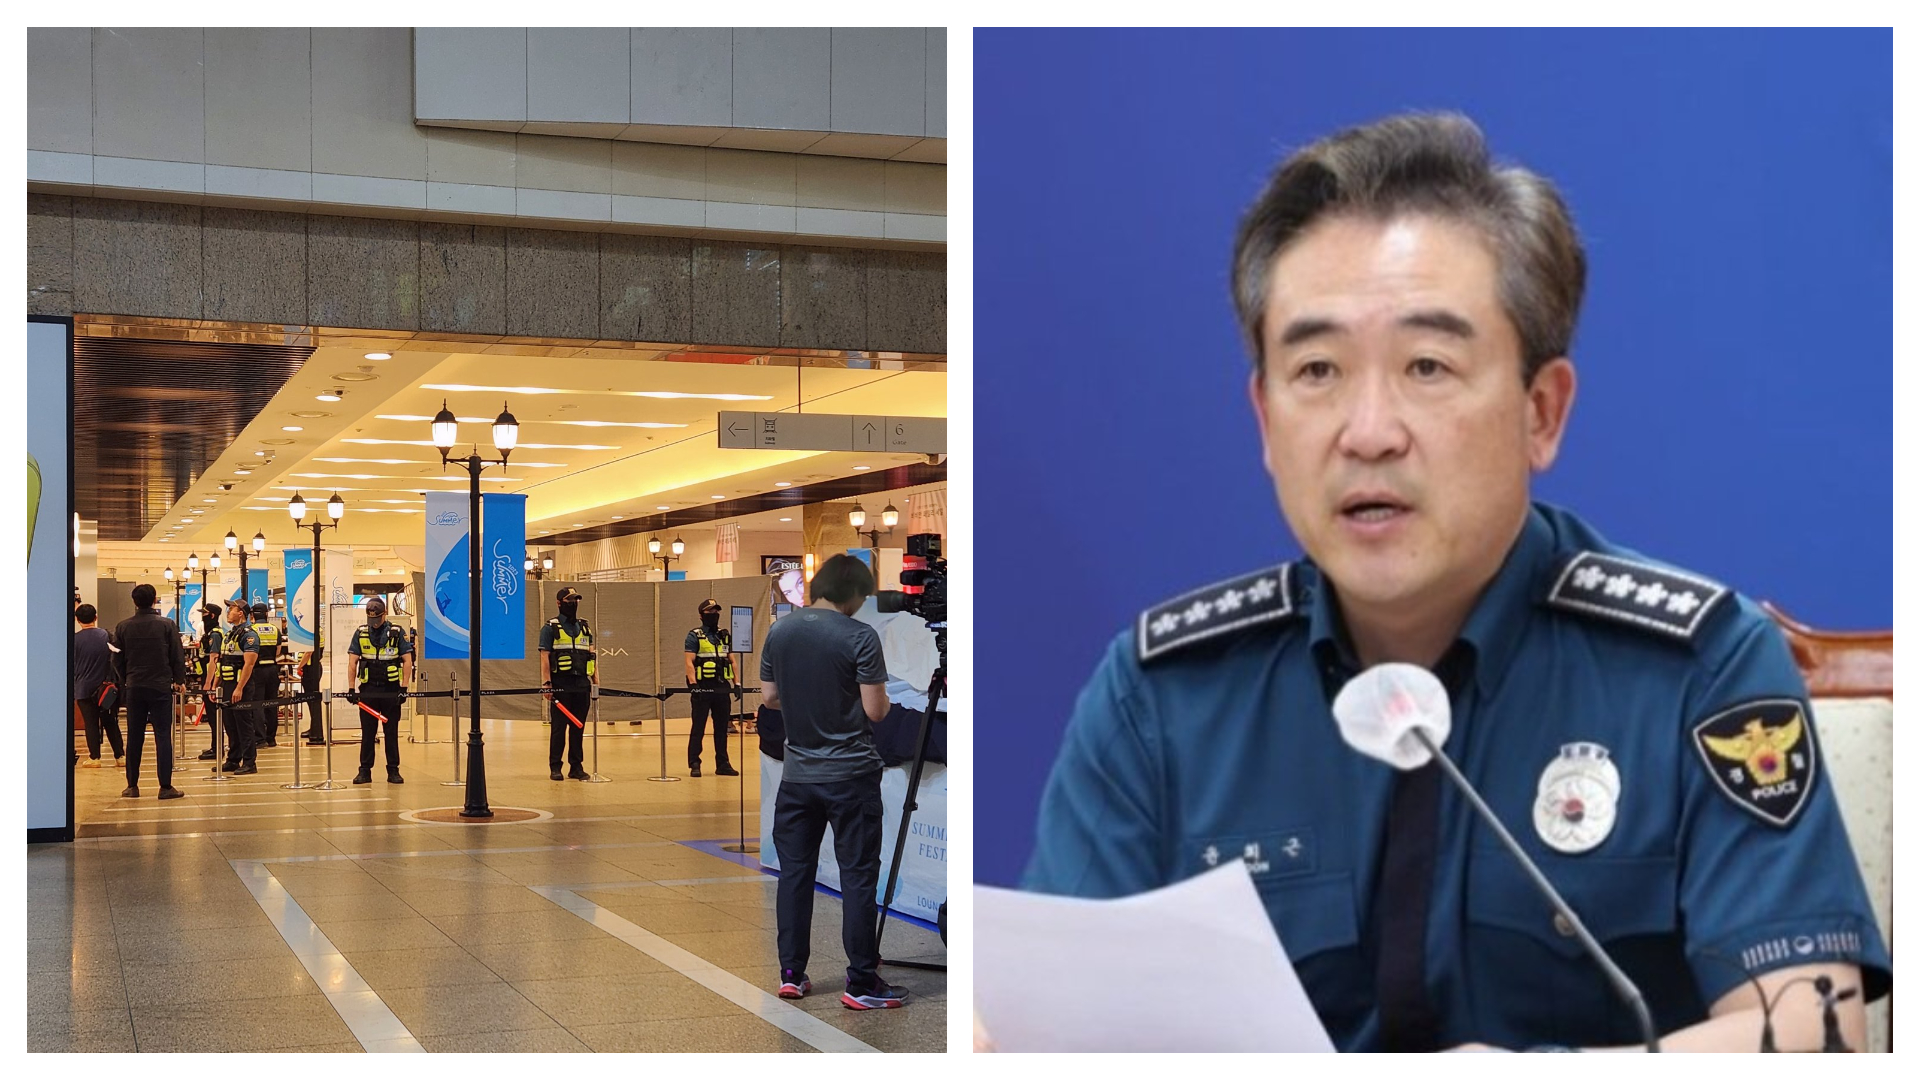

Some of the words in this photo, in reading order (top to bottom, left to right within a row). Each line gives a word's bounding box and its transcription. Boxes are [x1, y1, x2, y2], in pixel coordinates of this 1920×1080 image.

[895, 423, 904, 436] 6
[1751, 780, 1798, 801] POLICE
[912, 821, 947, 842] SUMM
[919, 843, 947, 863] FEST
[917, 895, 941, 912] LOUN
